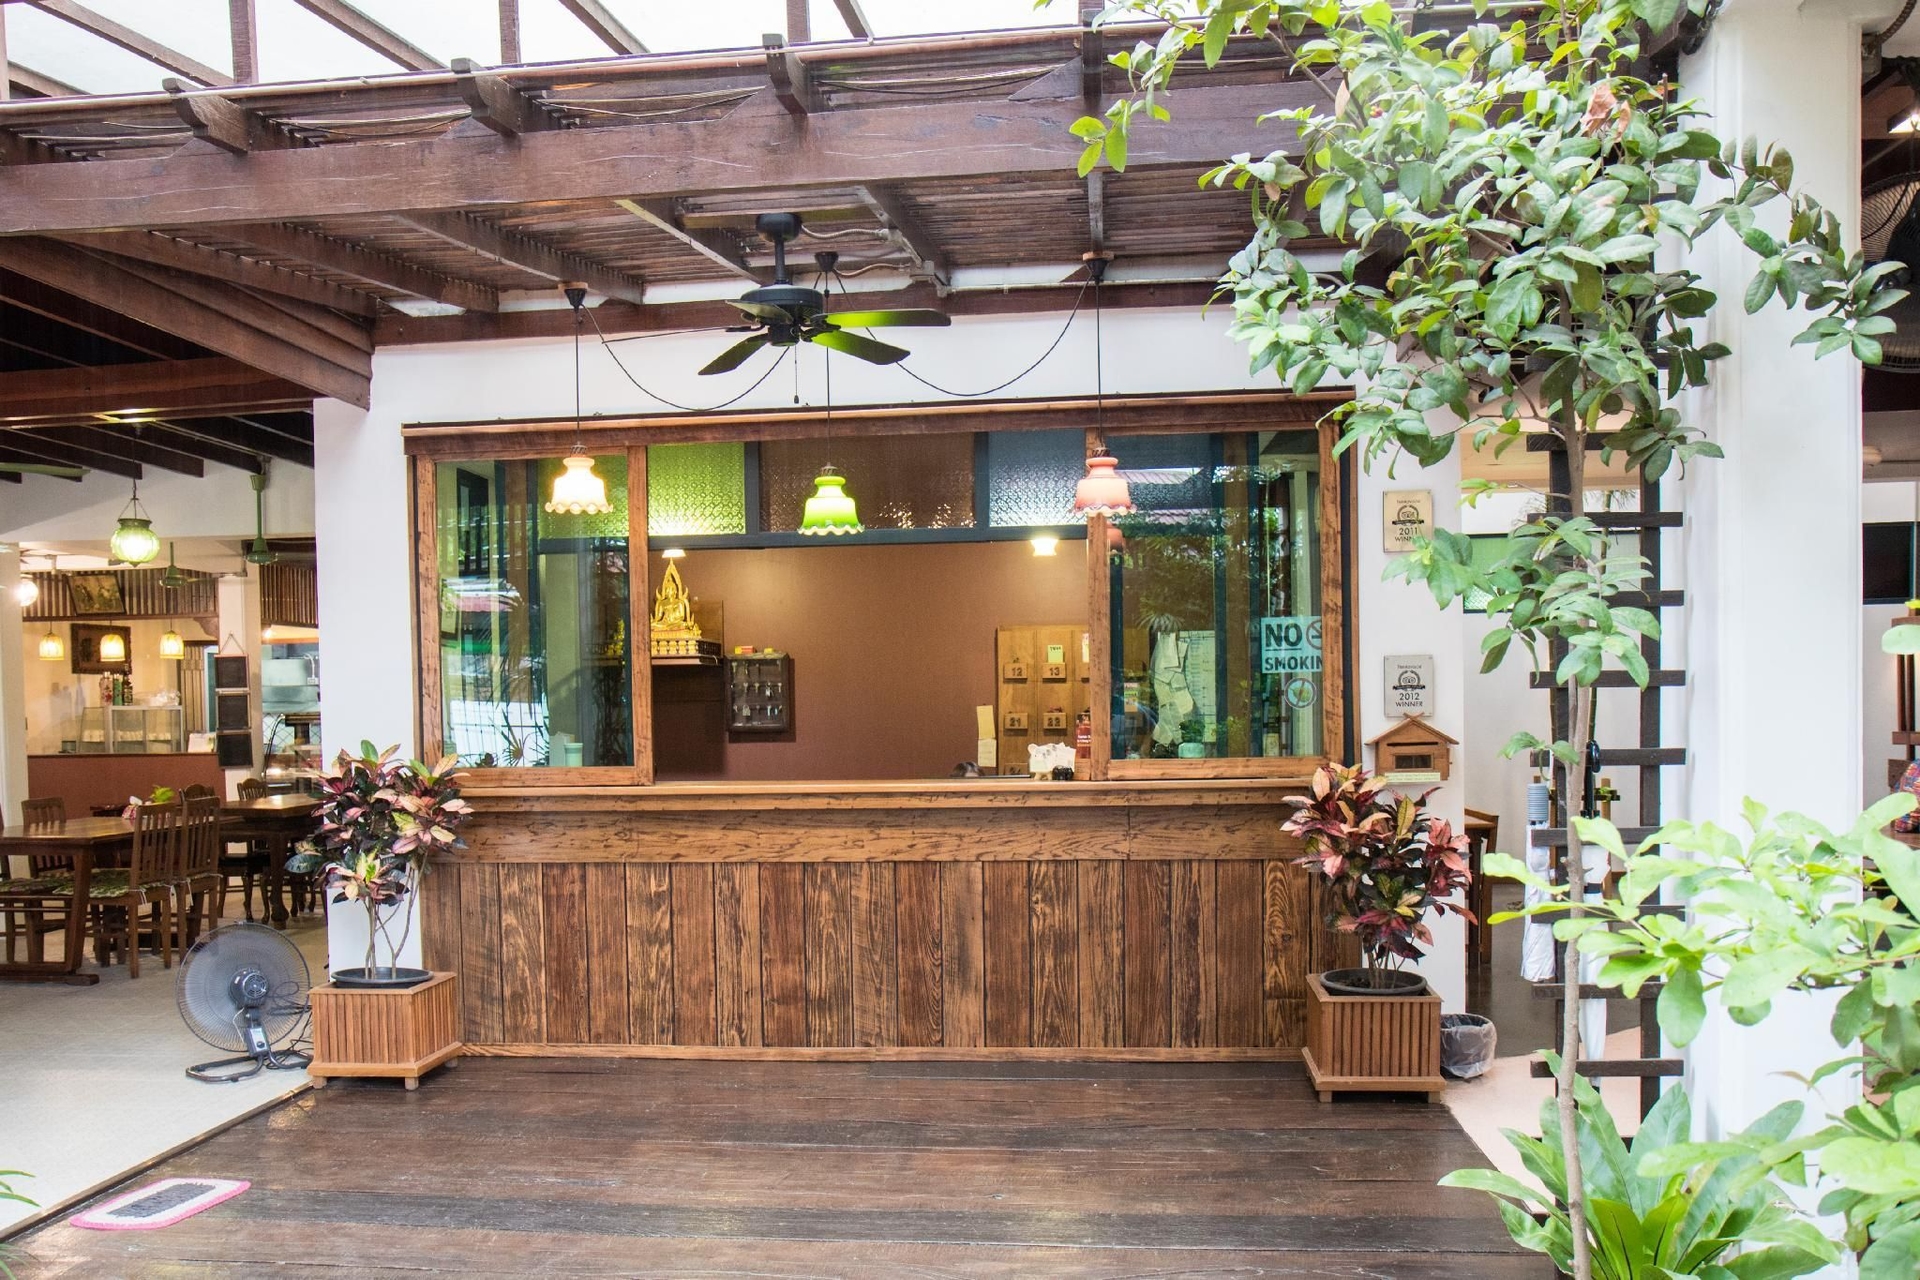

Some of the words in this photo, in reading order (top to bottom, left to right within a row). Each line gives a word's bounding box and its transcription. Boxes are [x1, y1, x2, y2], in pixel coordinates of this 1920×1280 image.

[1399, 527, 1418, 535] 2011
[1265, 622, 1303, 647] NO
[1265, 655, 1322, 671] SMOKIN
[1012, 667, 1023, 676] 12
[1049, 666, 1060, 676] 13
[1399, 692, 1420, 700] 2012
[1009, 717, 1021, 727] 21
[1047, 717, 1061, 727] 22
